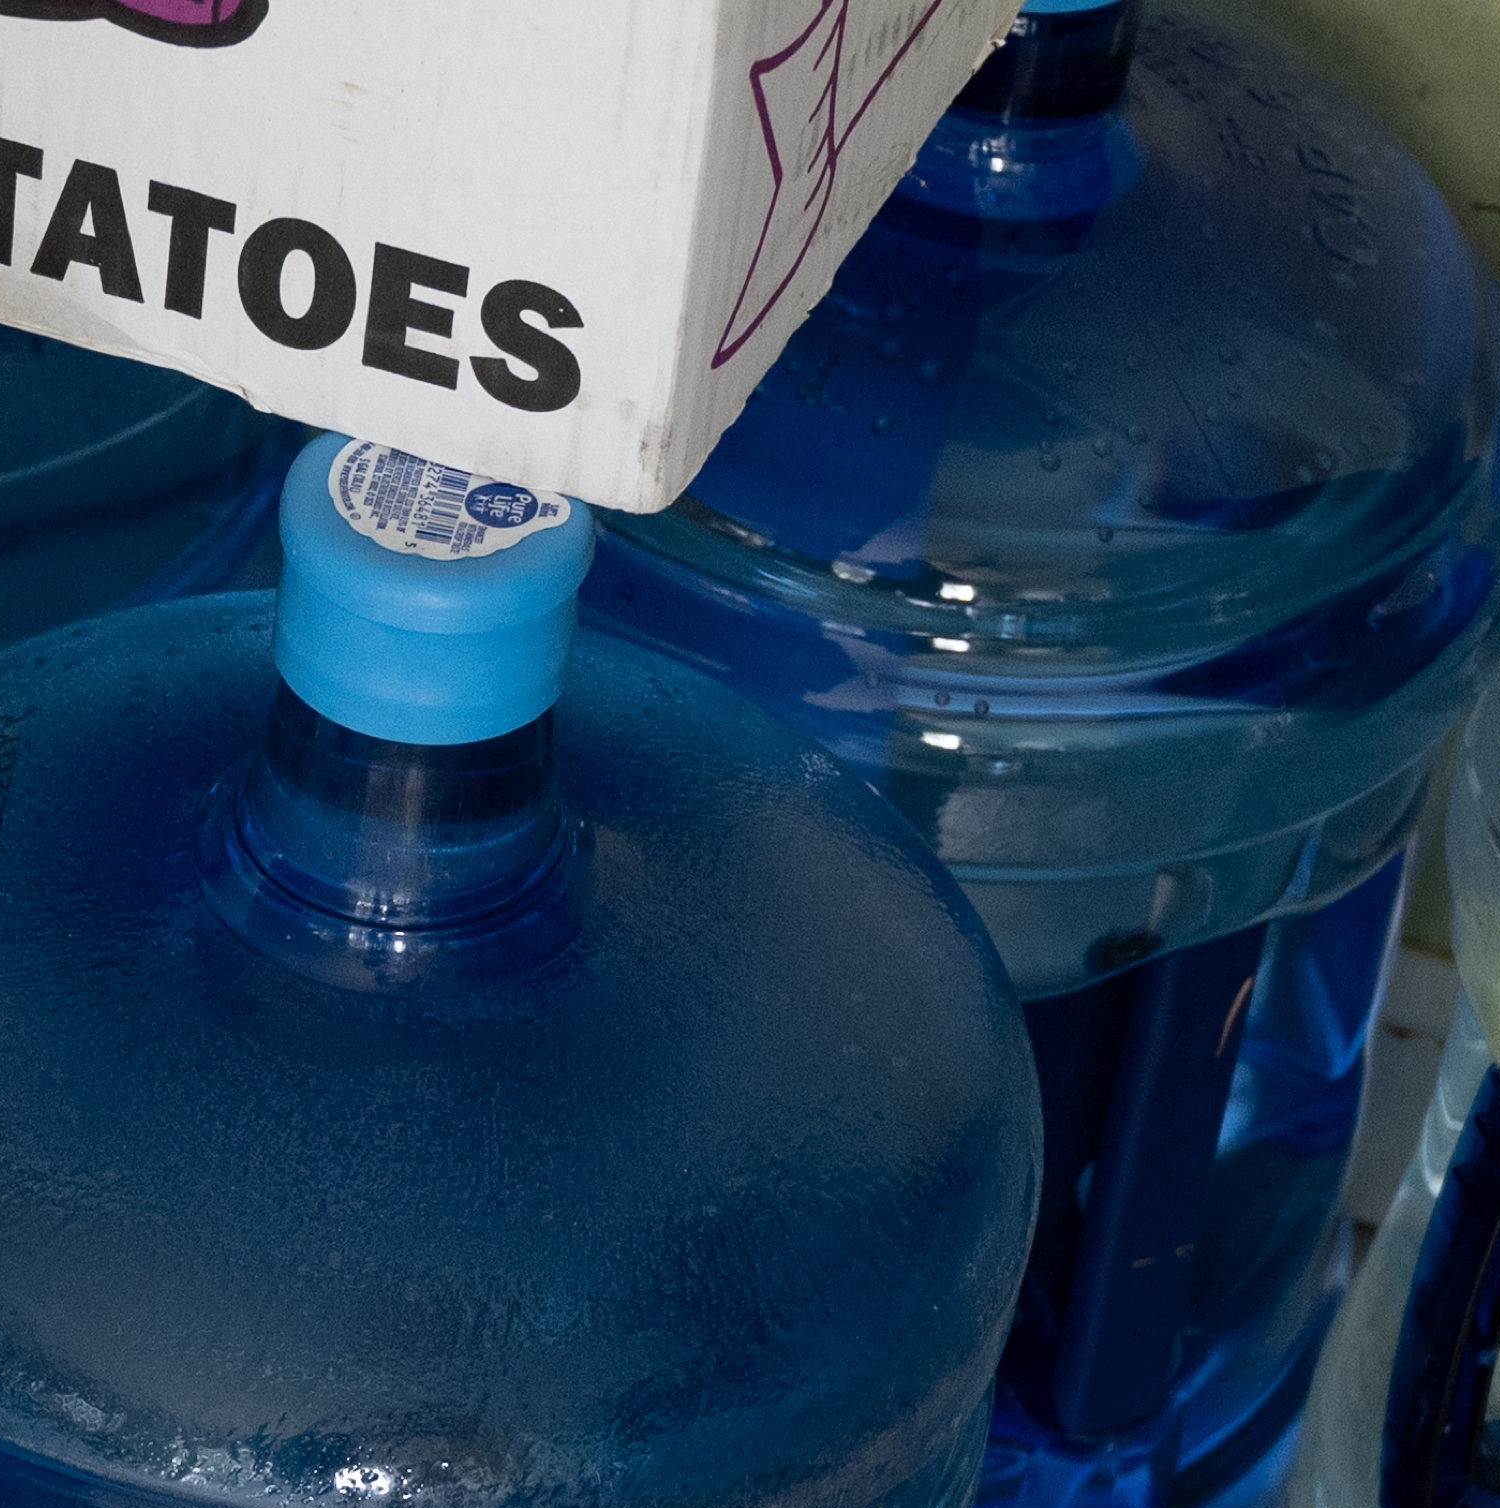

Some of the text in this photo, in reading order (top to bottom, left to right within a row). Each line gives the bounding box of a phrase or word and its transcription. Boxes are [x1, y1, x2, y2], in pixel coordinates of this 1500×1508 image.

[409, 494, 434, 528] 36481
[488, 494, 513, 518] Life
[507, 493, 533, 525] Pure
